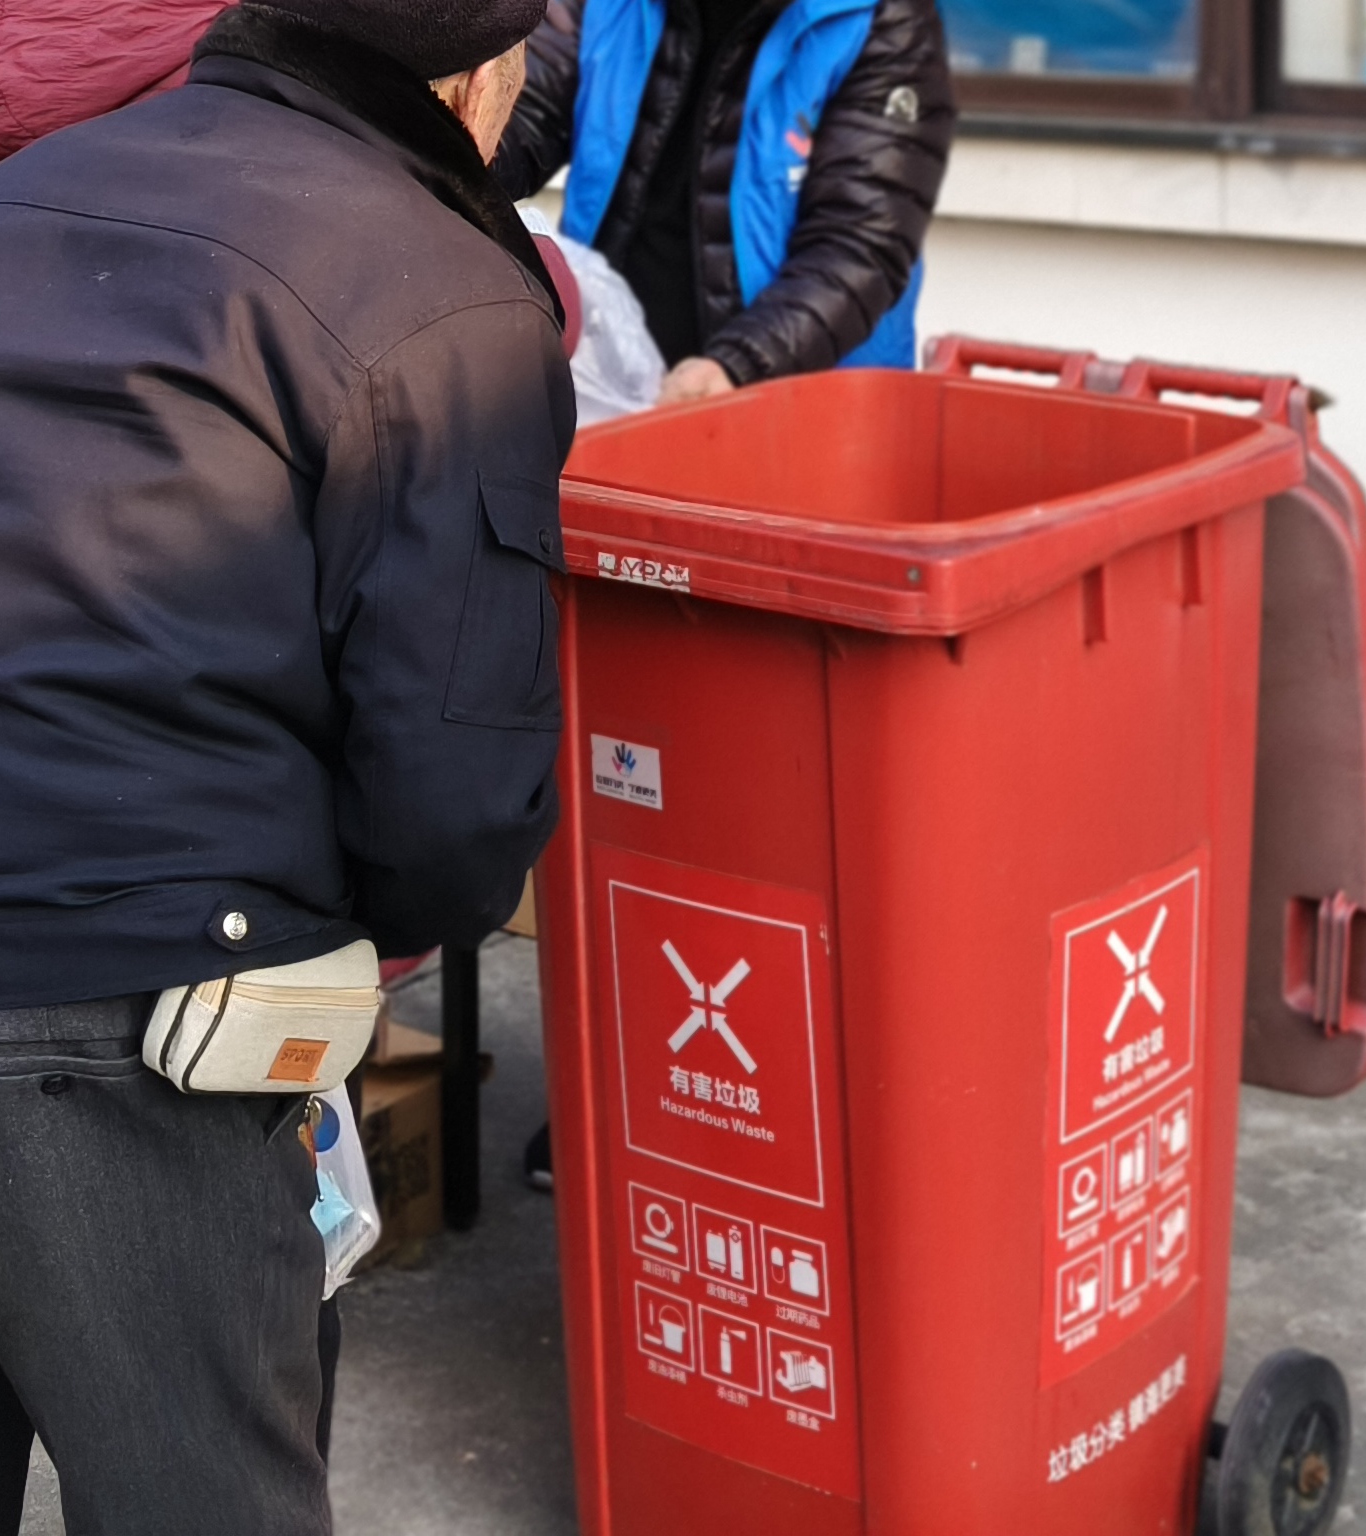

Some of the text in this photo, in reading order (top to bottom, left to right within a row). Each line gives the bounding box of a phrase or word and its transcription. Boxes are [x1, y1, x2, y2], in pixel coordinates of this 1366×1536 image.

[1102, 1025, 1164, 1083] 有害垃圾
[669, 1065, 761, 1115] 有害垃圾
[660, 1095, 775, 1142] Hazardous Waste
[776, 1305, 821, 1329] 过期药品
[716, 1384, 749, 1408] 杀虫剂
[1047, 1408, 1125, 1483] 垃圾分类
